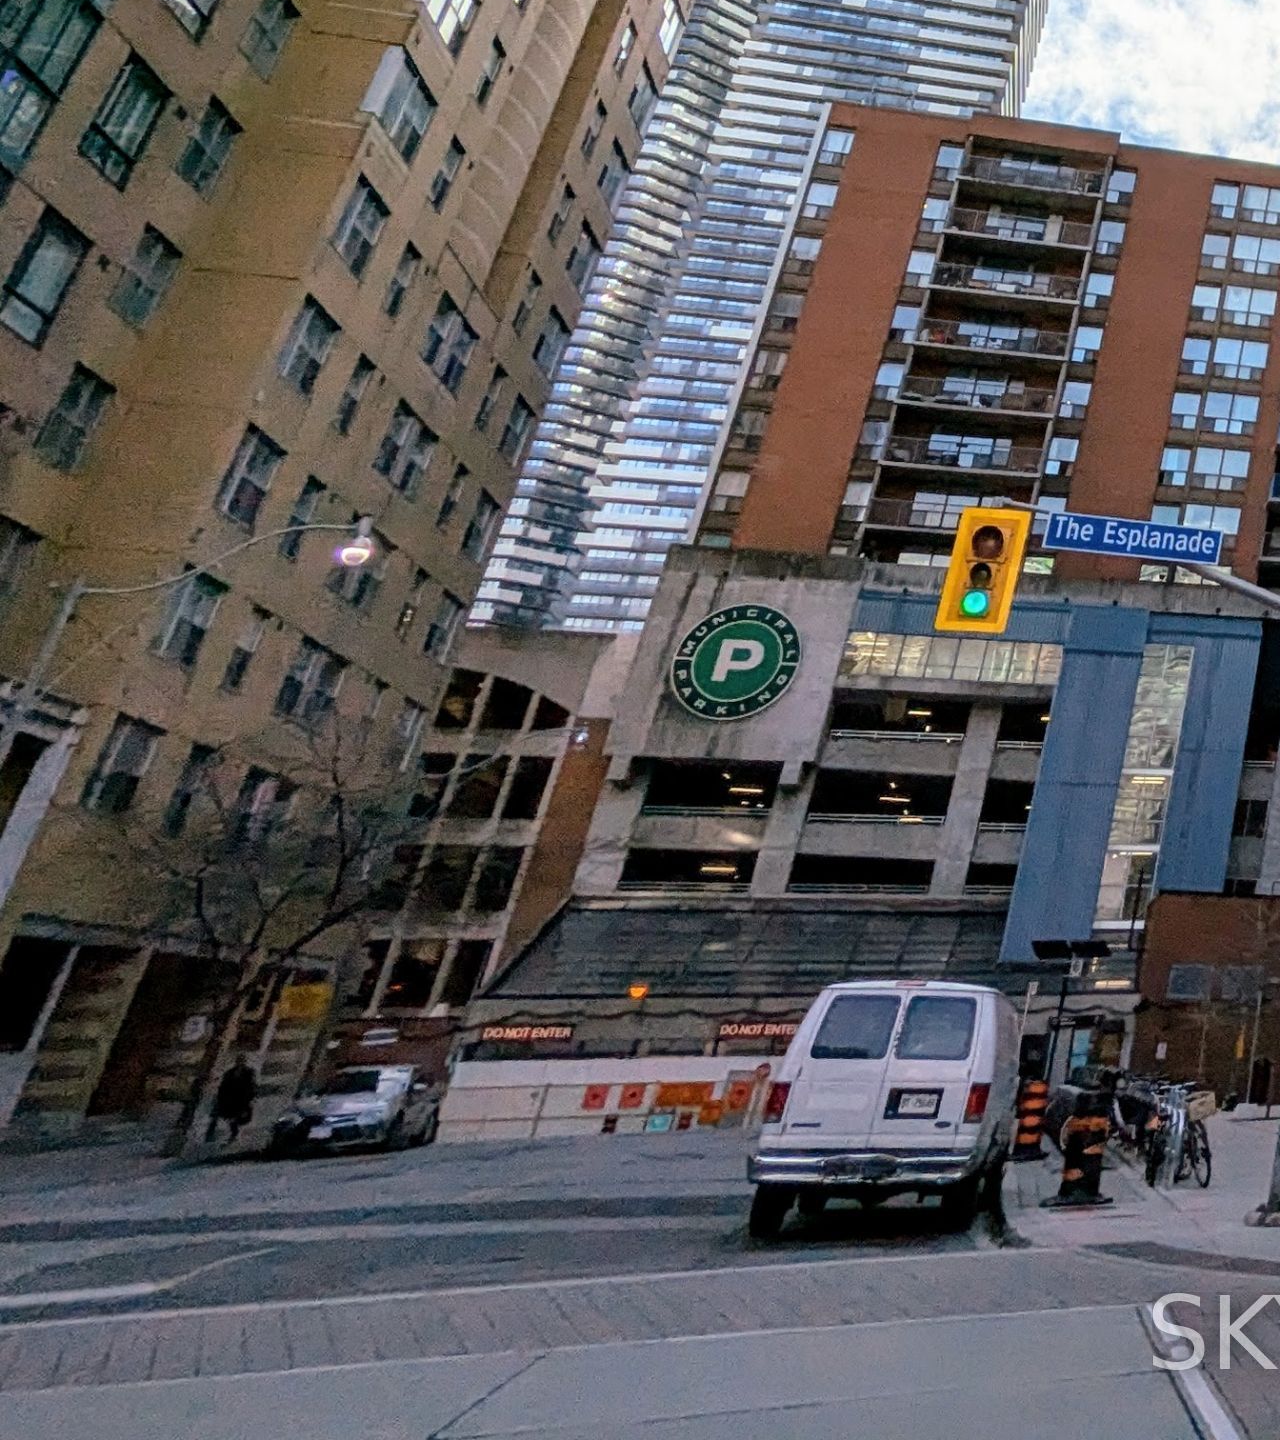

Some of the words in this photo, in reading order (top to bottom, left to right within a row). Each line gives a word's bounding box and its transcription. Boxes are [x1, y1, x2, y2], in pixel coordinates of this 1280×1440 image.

[1055, 516, 1094, 541] The
[1102, 521, 1215, 554] Esplanade
[682, 609, 797, 658] MUNICIPAL
[710, 638, 765, 682] P
[676, 670, 788, 715] PARKING
[482, 1026, 504, 1039] DO
[503, 1026, 532, 1039] NOT
[531, 1026, 572, 1039] ENTER
[720, 1023, 739, 1036] DO
[739, 1023, 765, 1036] NOT
[763, 1023, 797, 1036] ENTE
